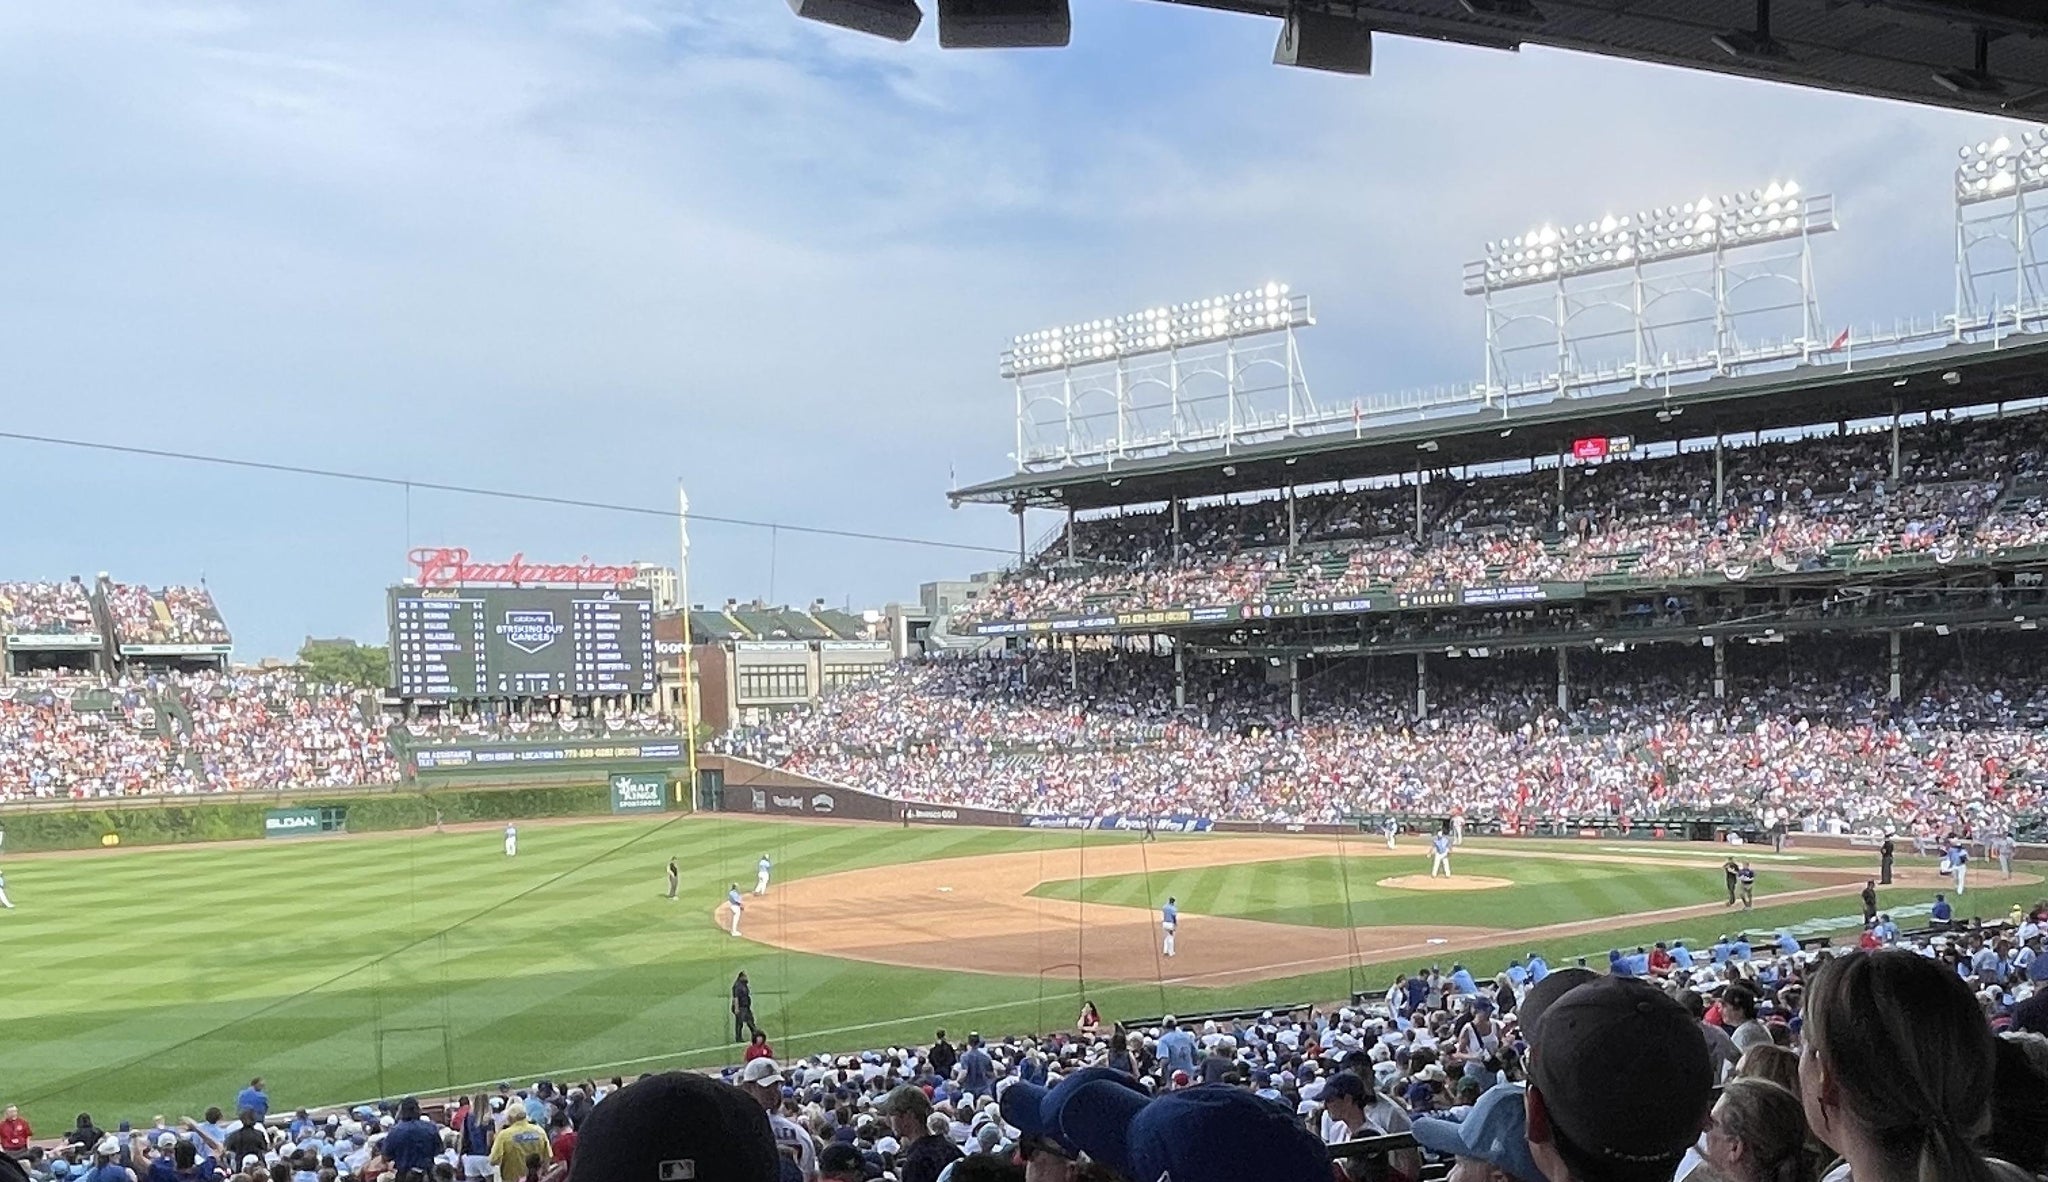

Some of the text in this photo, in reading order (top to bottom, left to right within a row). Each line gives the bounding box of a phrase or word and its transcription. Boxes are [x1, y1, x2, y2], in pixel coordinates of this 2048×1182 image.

[408, 548, 637, 587] Budweiser
[496, 625, 543, 634] STRIKING
[544, 625, 565, 634] OUT
[511, 633, 550, 641] CANCER
[616, 781, 659, 795] DRAFT
[623, 791, 658, 801] KINGS
[619, 799, 661, 808] SPORTSBOOK
[266, 816, 317, 829] SLOAN
